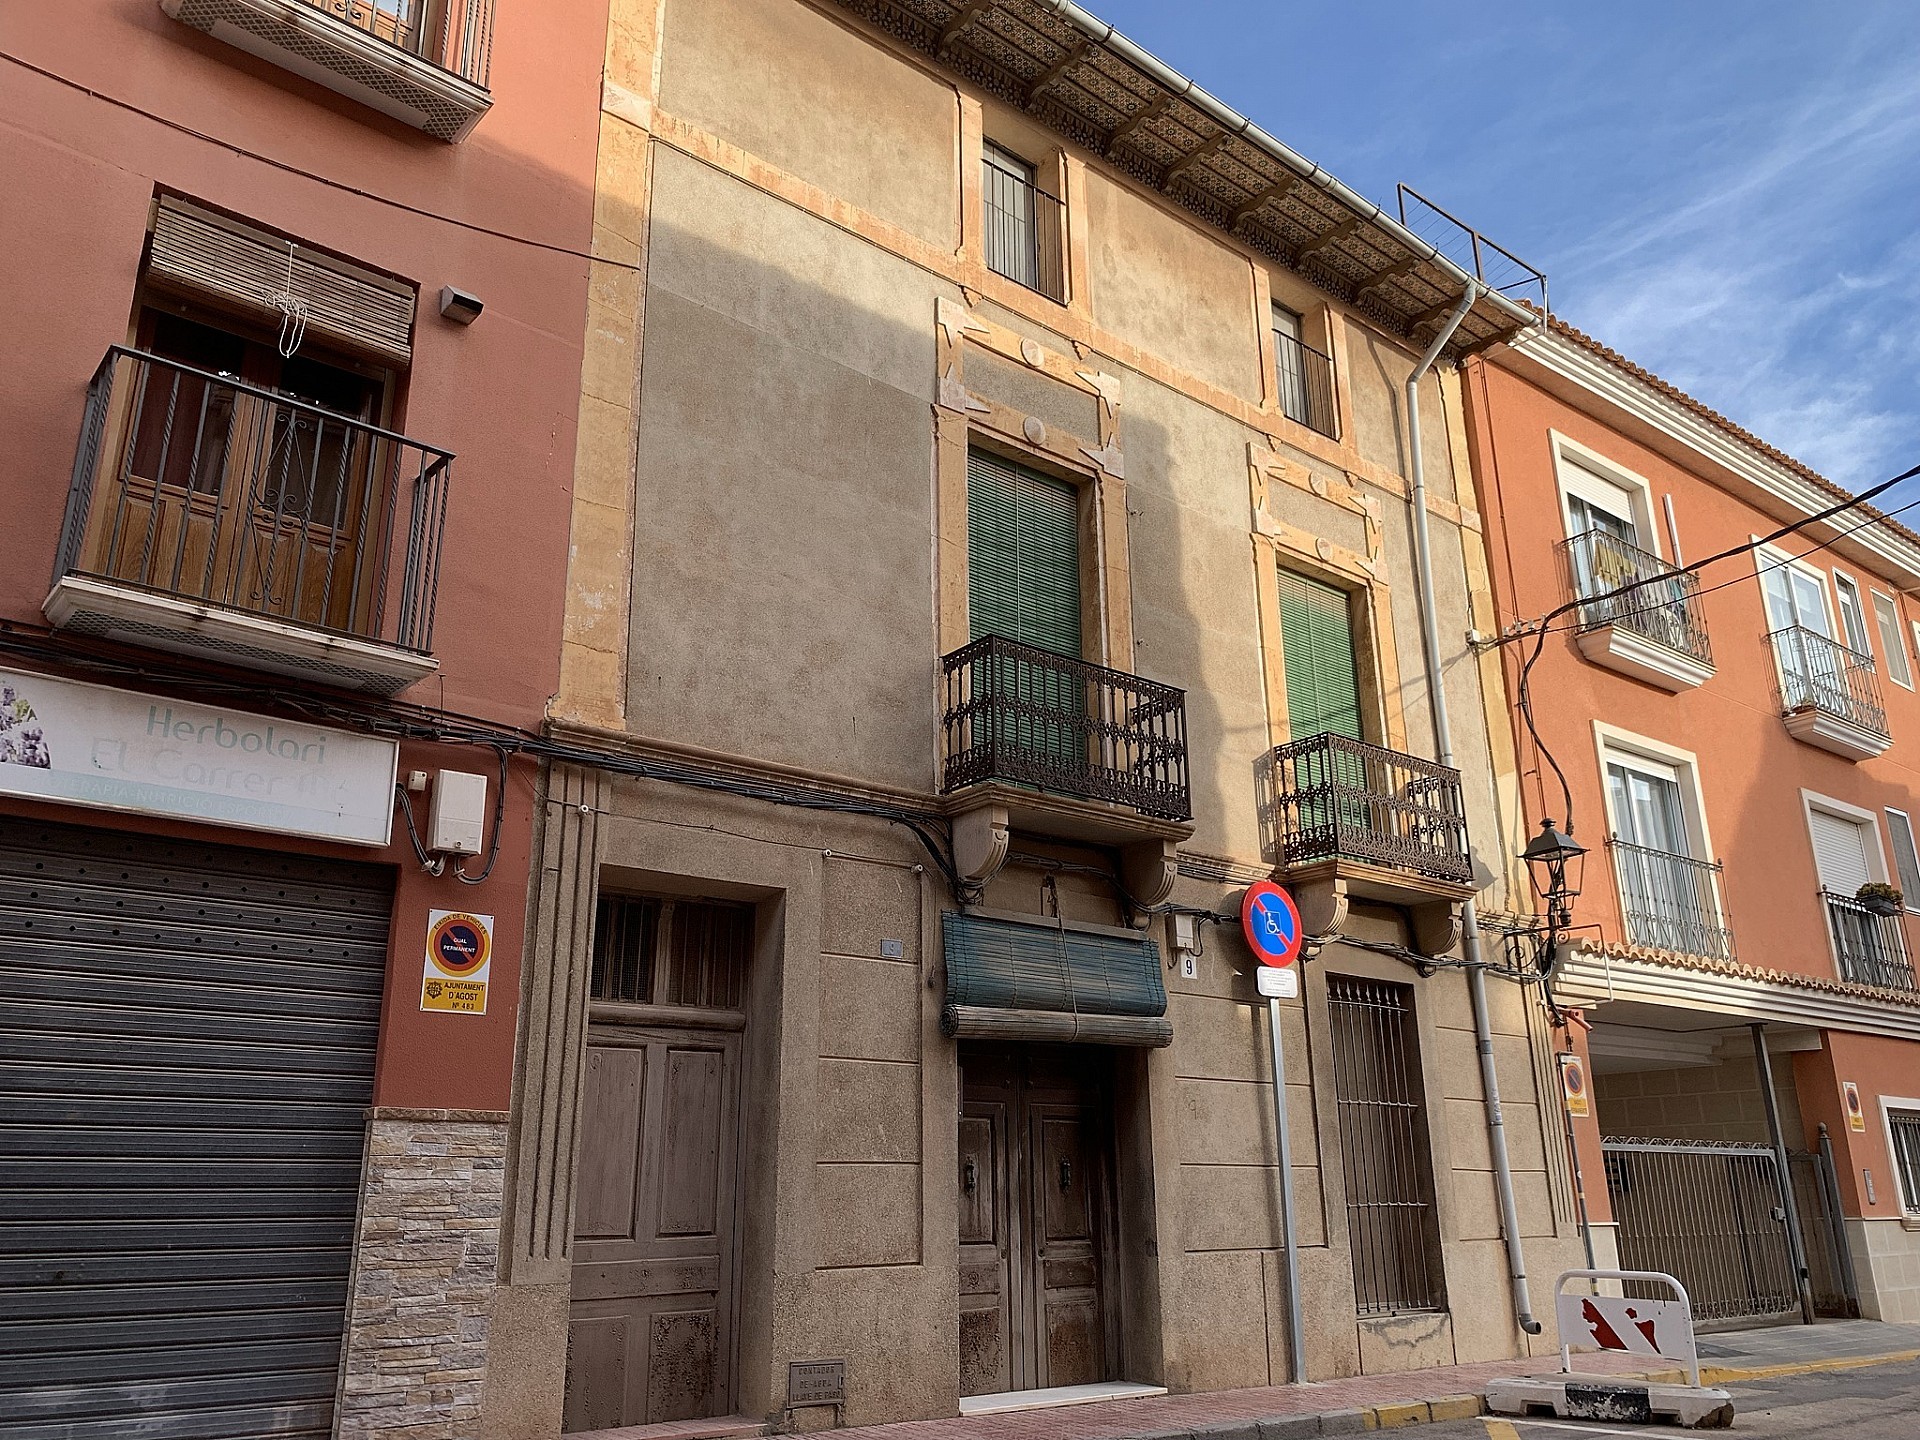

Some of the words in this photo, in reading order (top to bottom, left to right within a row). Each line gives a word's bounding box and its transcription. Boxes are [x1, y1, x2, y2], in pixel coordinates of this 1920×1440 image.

[146, 704, 326, 764] Herbolari
[91, 736, 127, 773] El
[151, 747, 281, 796] Carrer
[462, 914, 487, 935] VEHICLES
[443, 945, 475, 953] PERMANENT
[1186, 959, 1193, 975] 9
[444, 982, 485, 991] AJUNTAMENT
